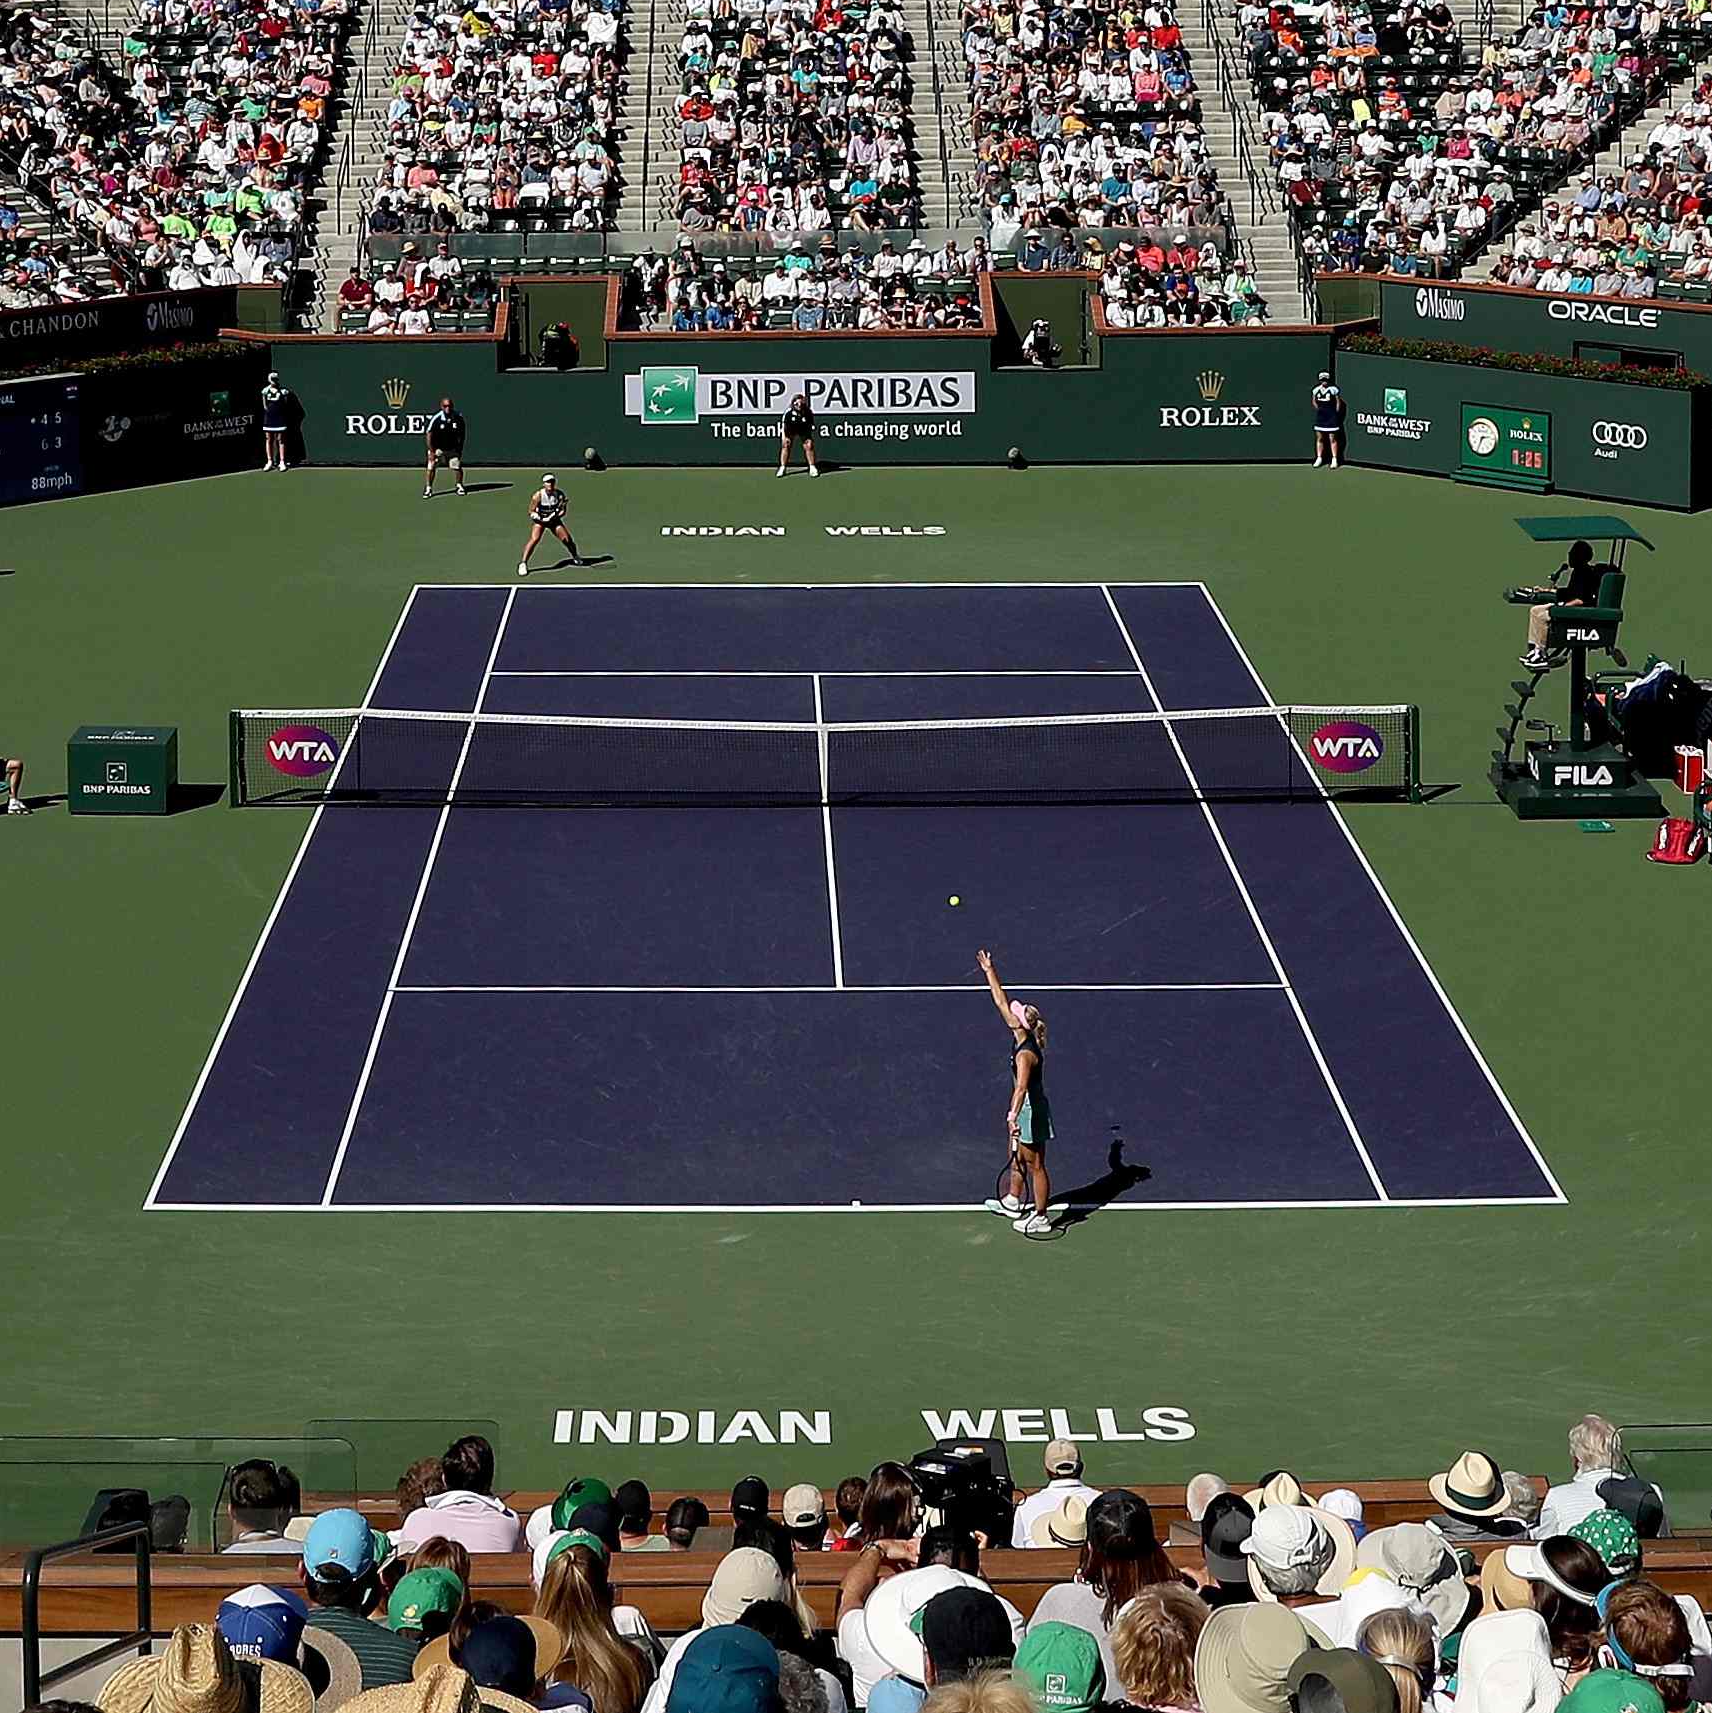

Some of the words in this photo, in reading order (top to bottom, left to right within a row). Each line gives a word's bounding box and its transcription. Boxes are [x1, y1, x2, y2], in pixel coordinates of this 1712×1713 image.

[1547, 300, 1659, 328] ORACLE
[8, 310, 100, 341] CHANDON
[709, 379, 787, 410] BNP
[803, 376, 961, 409] PARIBAS
[40, 413, 48, 425] 4
[54, 411, 62, 424] 5
[183, 420, 214, 435] BANK
[224, 413, 256, 428] WEST
[345, 414, 433, 435] ROLE
[1159, 406, 1263, 428] ROLEX
[1357, 411, 1387, 430] BANK
[1397, 418, 1432, 433] WEST
[710, 423, 741, 438] The
[746, 422, 784, 439] bank
[820, 424, 830, 438] a
[834, 421, 909, 441] changing
[913, 420, 963, 437] world
[1367, 426, 1385, 435] BNP
[1385, 427, 1422, 440] PARIBAS
[1509, 429, 1544, 443] ROLEX
[54, 436, 62, 449] 3
[1511, 449, 1543, 468] 1:25
[1594, 448, 1618, 459] Audi
[31, 472, 73, 490] 88mph
[660, 526, 786, 537] INDIAN
[824, 525, 947, 537] WELLS
[1566, 628, 1600, 642] FILA
[268, 741, 335, 762] WTA
[1313, 738, 1380, 758] WTA
[1554, 765, 1613, 786] FILA
[82, 785, 105, 795] BNP
[106, 784, 151, 795] PARIBAS
[552, 1409, 832, 1445] INDIAN
[920, 1406, 1198, 1443] WELLS
